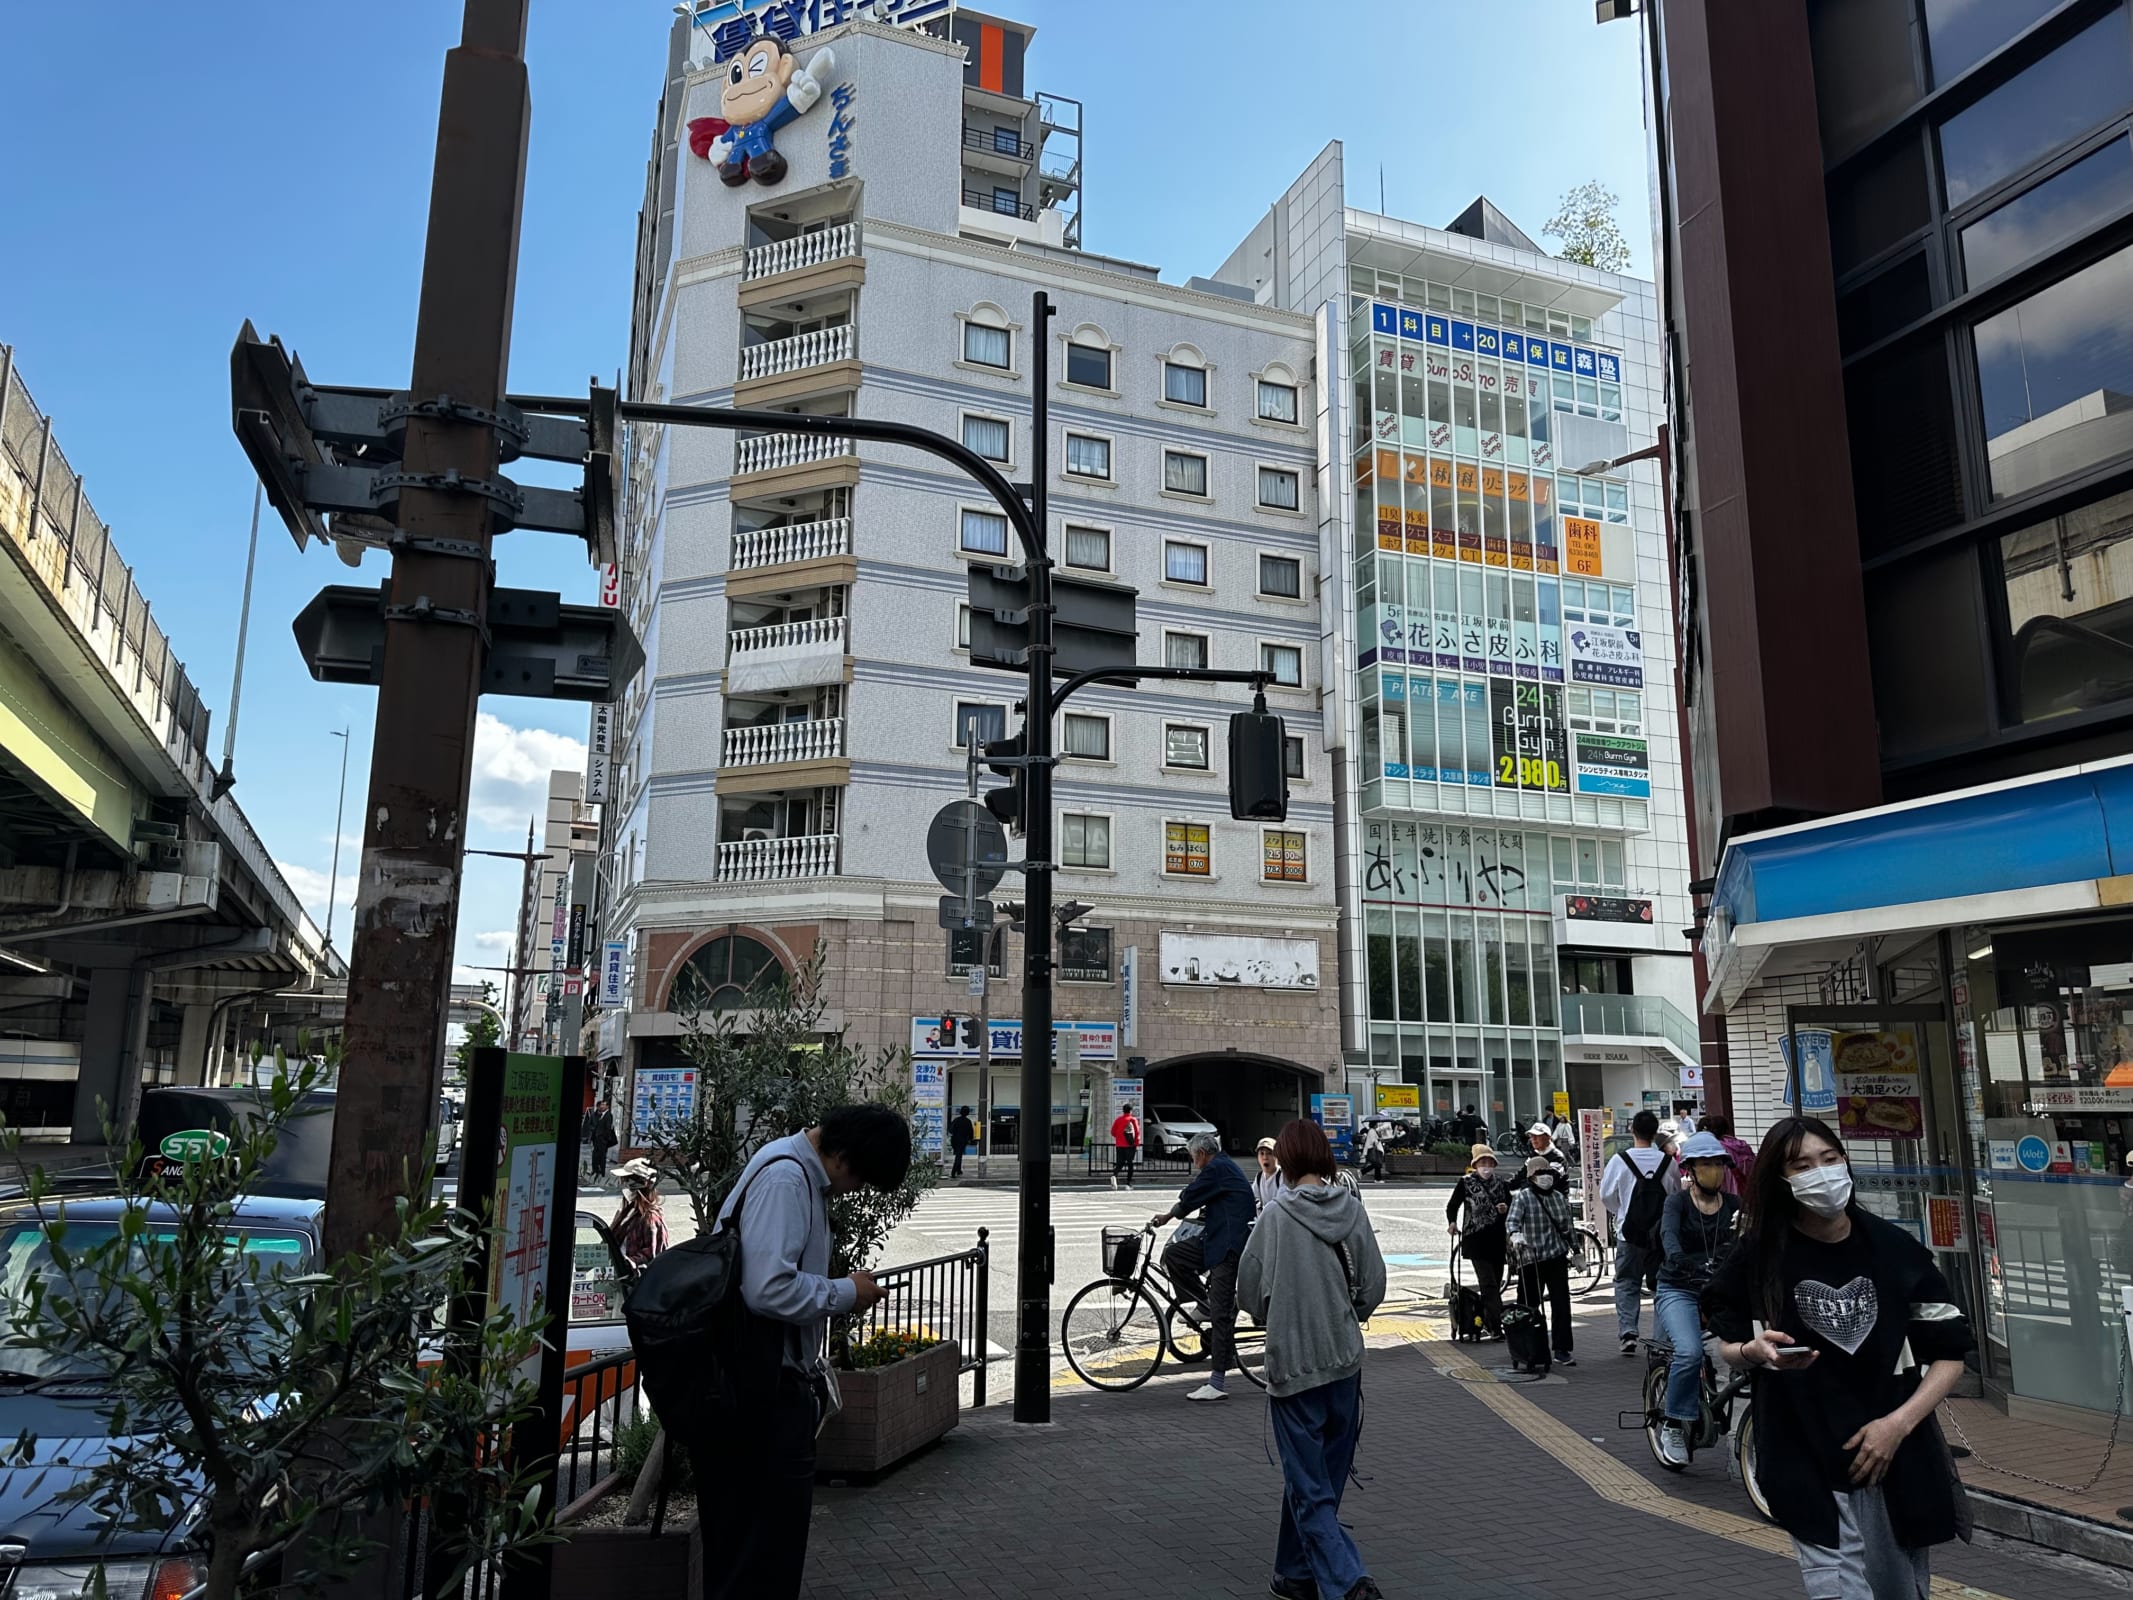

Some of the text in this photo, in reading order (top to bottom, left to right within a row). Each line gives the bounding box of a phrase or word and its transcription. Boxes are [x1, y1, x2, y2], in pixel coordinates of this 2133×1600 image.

[1568, 522, 1597, 542] 歯科
[1577, 559, 1592, 572] 6F
[1407, 622, 1562, 665] 花ふさ皮ふ科
[1591, 636, 1624, 650] 江坂駅前
[1591, 647, 1640, 663] 花ふさ皮ふ科
[592, 759, 603, 797] システム
[1499, 755, 1560, 788] 2,980
[607, 951, 621, 995] 賃貸住宅
[1850, 1084, 1912, 1096] 大満足パン!
[2022, 1149, 2045, 1159] Wolt
[574, 1283, 593, 1291] ETC
